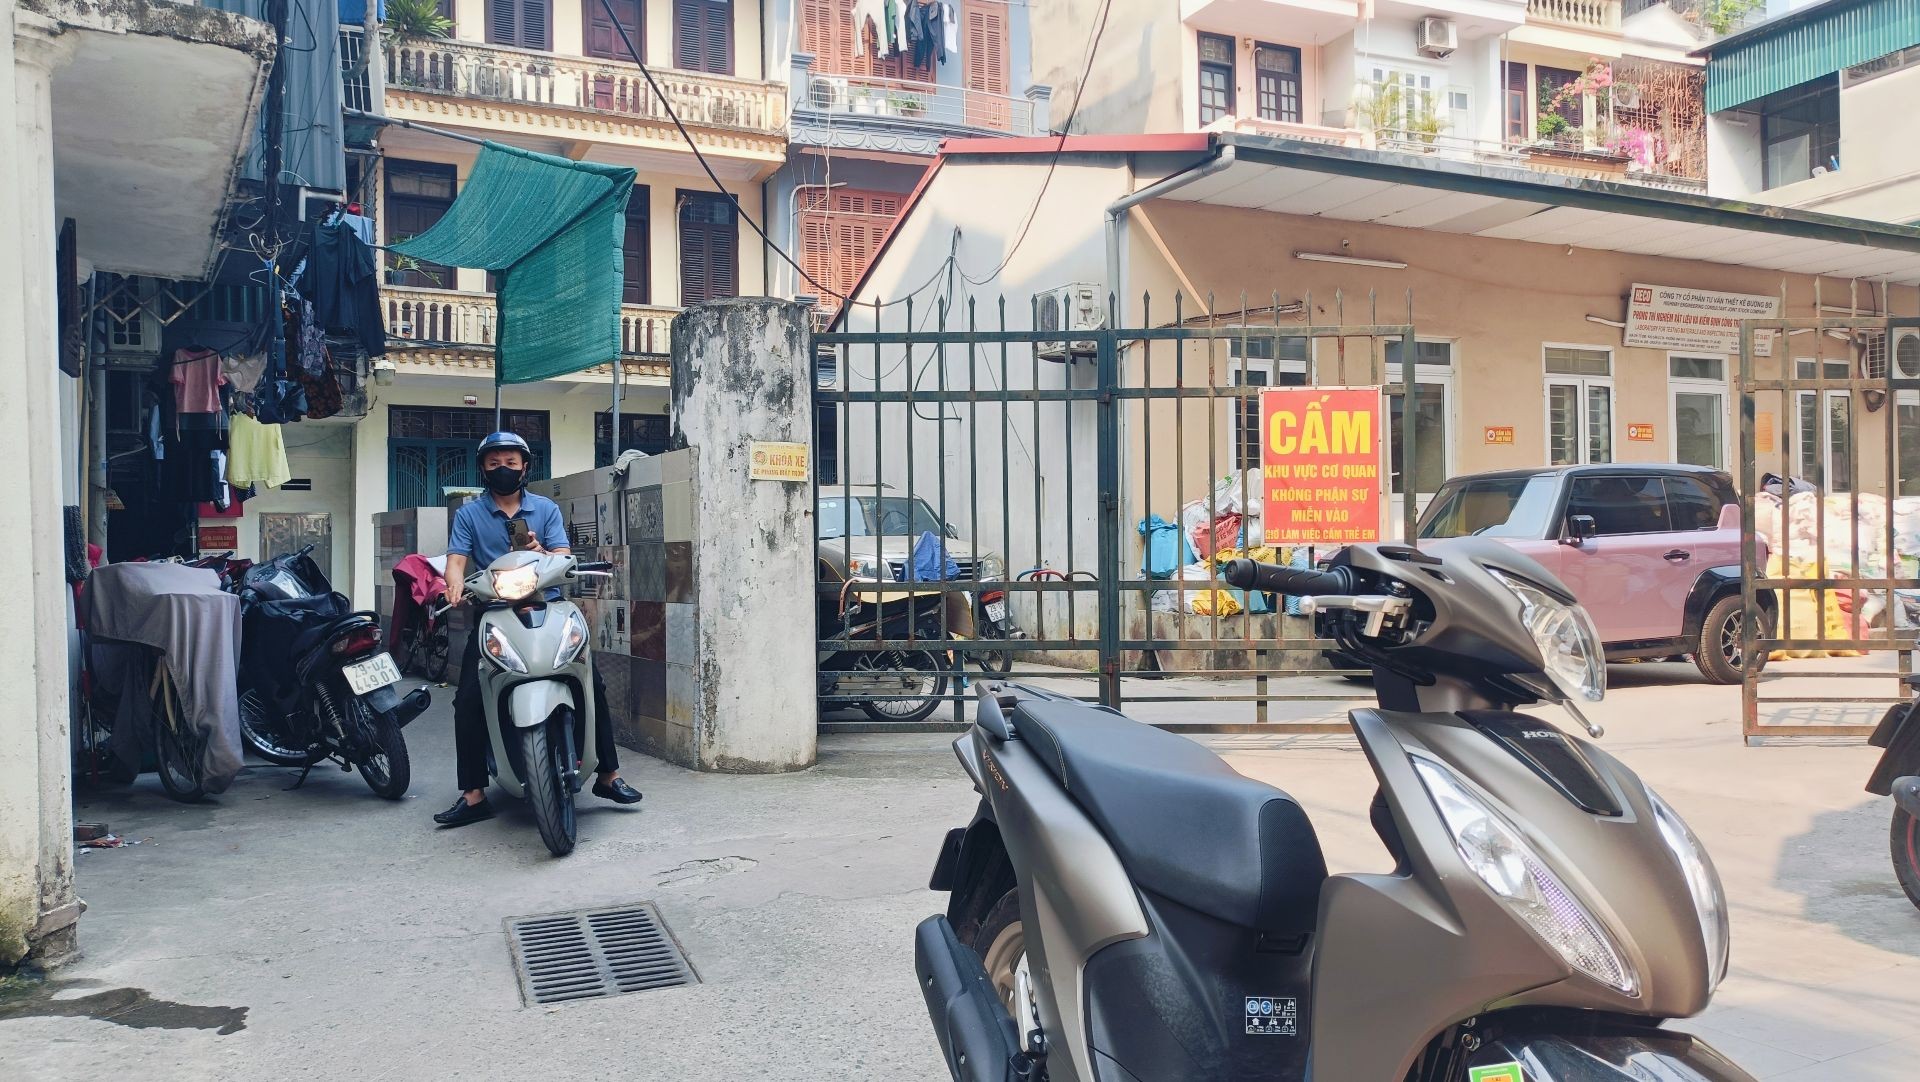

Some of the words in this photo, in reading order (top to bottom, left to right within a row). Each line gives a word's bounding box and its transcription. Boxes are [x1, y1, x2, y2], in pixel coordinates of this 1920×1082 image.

[1659, 290, 1674, 299] CÔNG
[1270, 394, 1371, 455] CẤM
[770, 452, 792, 466] KHÓA
[796, 456, 804, 467] XE
[1265, 465, 1289, 478] KHU
[1294, 464, 1317, 481] VỰC
[1322, 464, 1339, 478] CƠ
[1342, 465, 1376, 479] QUAN
[1272, 486, 1311, 502] KHÔNG
[1315, 486, 1348, 504] PHẬN
[1352, 488, 1369, 504] SỰ
[1292, 505, 1322, 522] MIỄN
[1326, 507, 1349, 522] VÀO
[1265, 528, 1279, 540] GIỜ
[1282, 527, 1299, 540] LÀM
[1302, 528, 1320, 542] VIỆC
[1323, 526, 1342, 540] CẤM
[1345, 526, 1360, 540] TRẺ
[1363, 530, 1375, 540] EM
